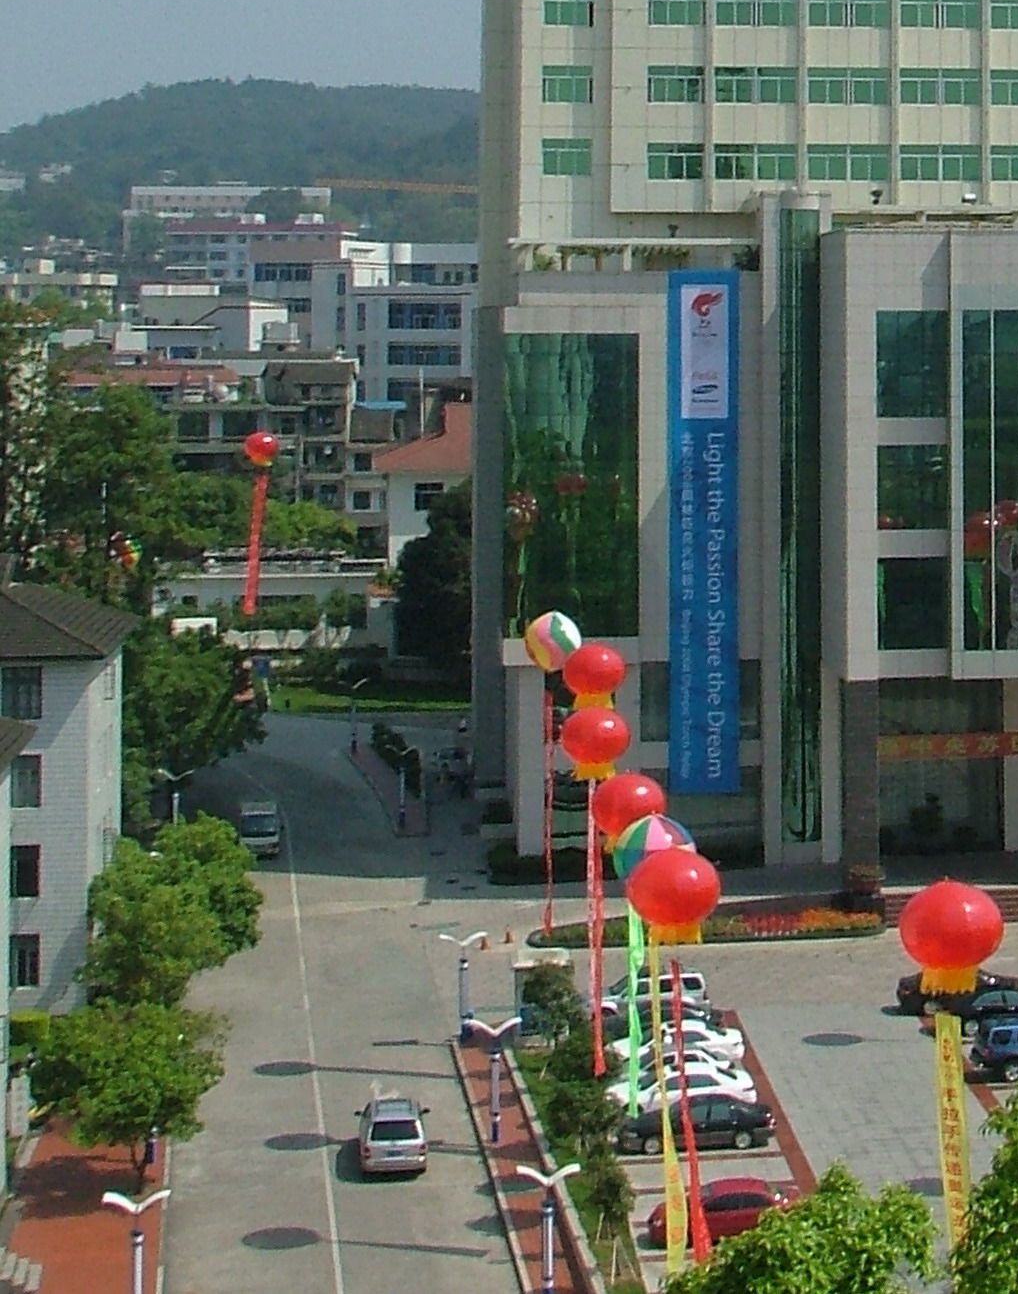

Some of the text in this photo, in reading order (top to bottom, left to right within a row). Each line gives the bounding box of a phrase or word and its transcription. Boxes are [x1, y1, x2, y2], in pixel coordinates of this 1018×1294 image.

[703, 432, 727, 779] Light the Passion Share the Dream
